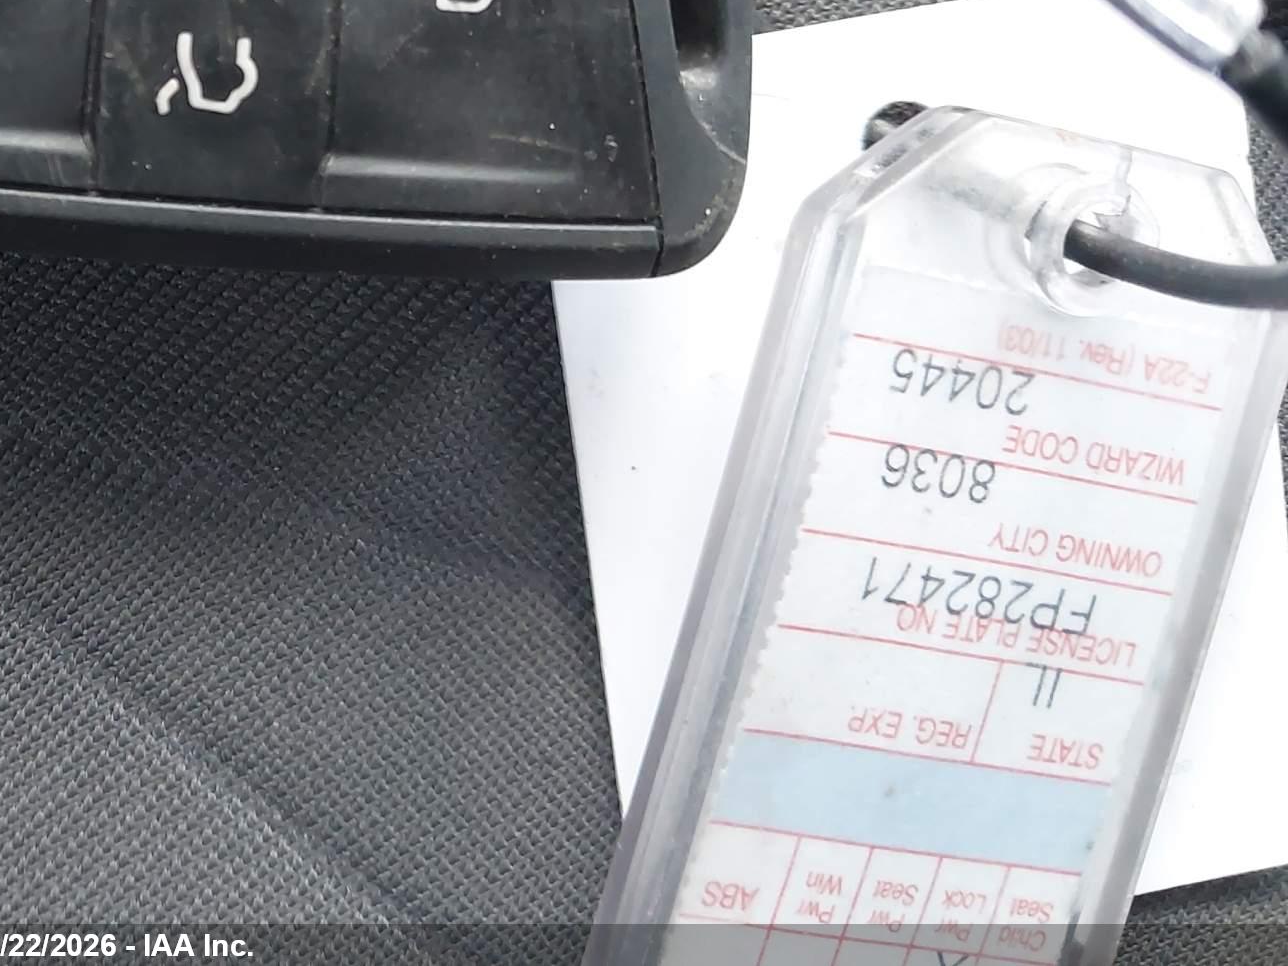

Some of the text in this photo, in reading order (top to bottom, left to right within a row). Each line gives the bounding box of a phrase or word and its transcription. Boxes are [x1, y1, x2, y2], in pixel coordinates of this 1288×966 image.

[889, 348, 1035, 416] 20445
[1001, 425, 1184, 486] WIZARD CODE
[881, 444, 995, 504] 8036
[987, 522, 1163, 578] OWNING CITY
[861, 556, 1097, 635] FP282471
[942, 612, 1021, 648] PLATE
[1026, 627, 1136, 667] LICENSE
[1025, 662, 1063, 709] IL
[847, 705, 972, 749] REG. EXP.
[1026, 734, 1103, 770] STATE
[700, 880, 760, 911] ABS
[805, 870, 844, 895] Win
[872, 879, 919, 906] Seat
[942, 889, 987, 912] Lock
[795, 899, 836, 924] Pwr
[867, 909, 906, 933] Pwr
[1009, 897, 1054, 924] Seat
[935, 917, 973, 942] Pwr
[997, 926, 1047, 952] Child
